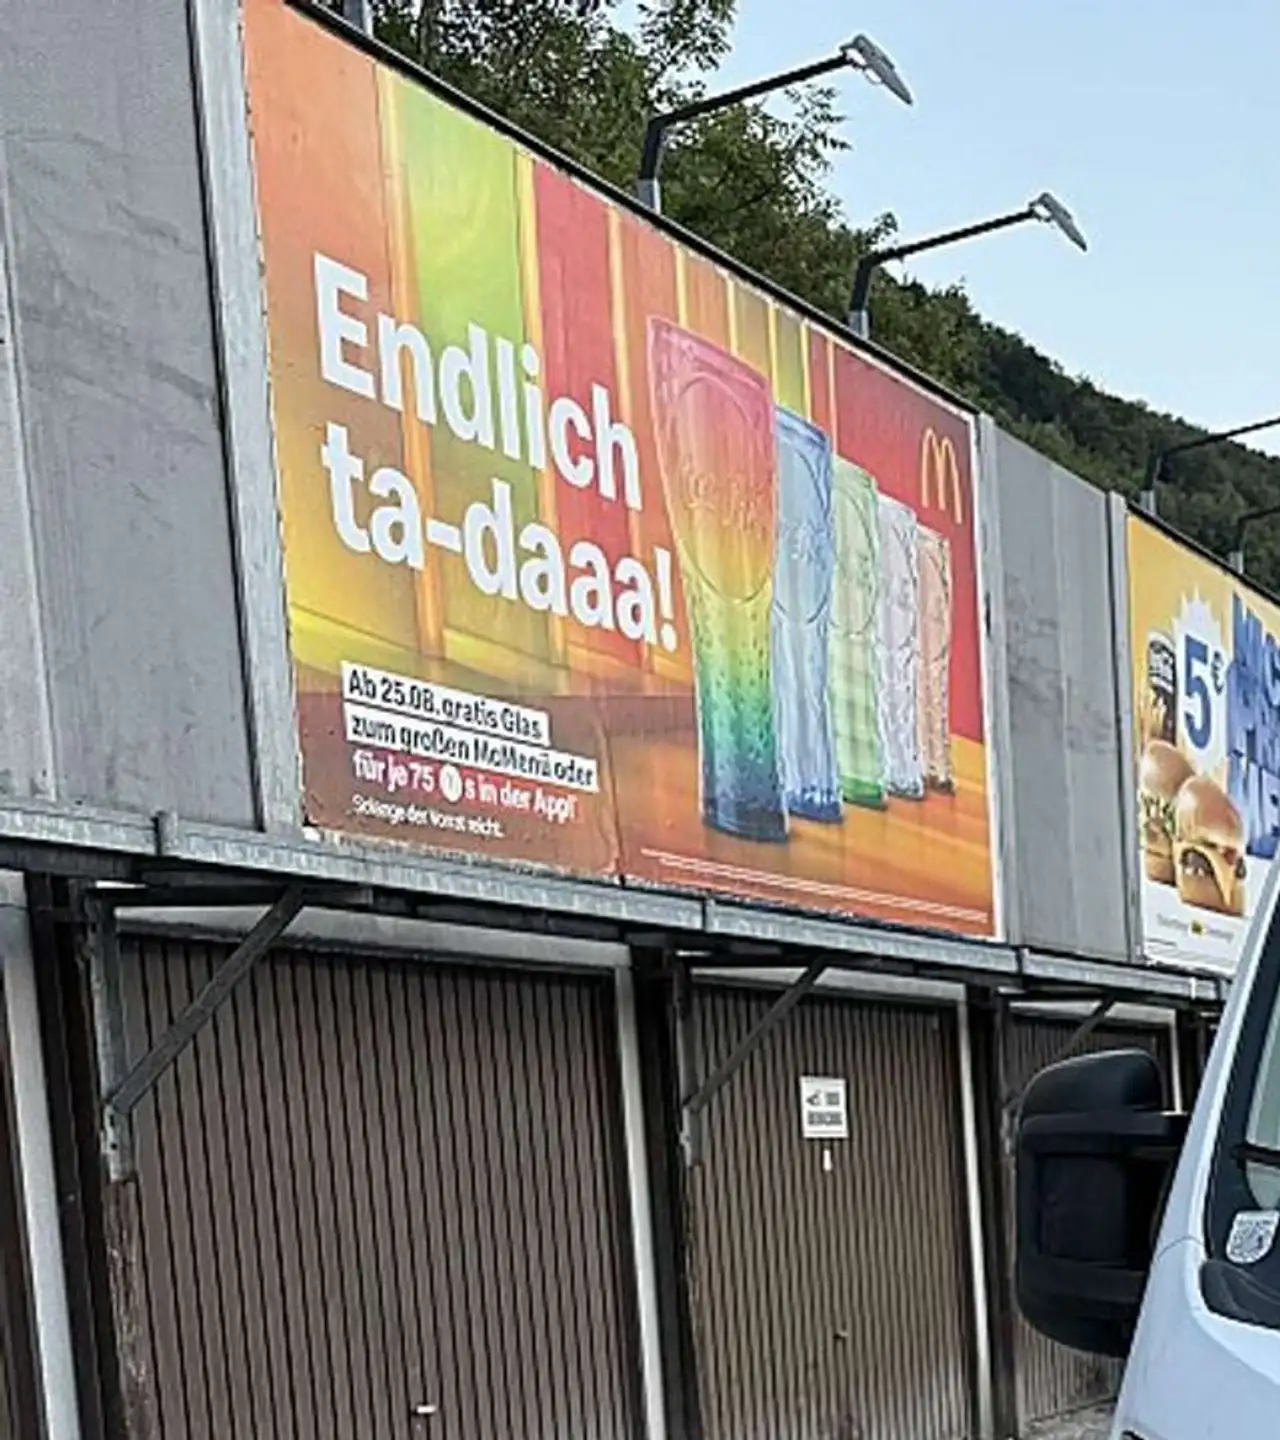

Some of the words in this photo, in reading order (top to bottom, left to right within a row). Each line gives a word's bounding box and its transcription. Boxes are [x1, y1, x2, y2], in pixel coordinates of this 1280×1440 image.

[314, 251, 642, 511] Endlich
[321, 422, 677, 653] ta-daaa!
[349, 668, 377, 699] Ab
[442, 697, 498, 729] gratis
[500, 708, 543, 740] Glas
[351, 714, 396, 746] zum
[400, 723, 471, 761] großen
[554, 758, 594, 787] oder
[353, 749, 384, 784] für
[387, 753, 408, 793] je
[410, 764, 435, 792] 75
[478, 773, 499, 808] in
[499, 780, 531, 813] der
